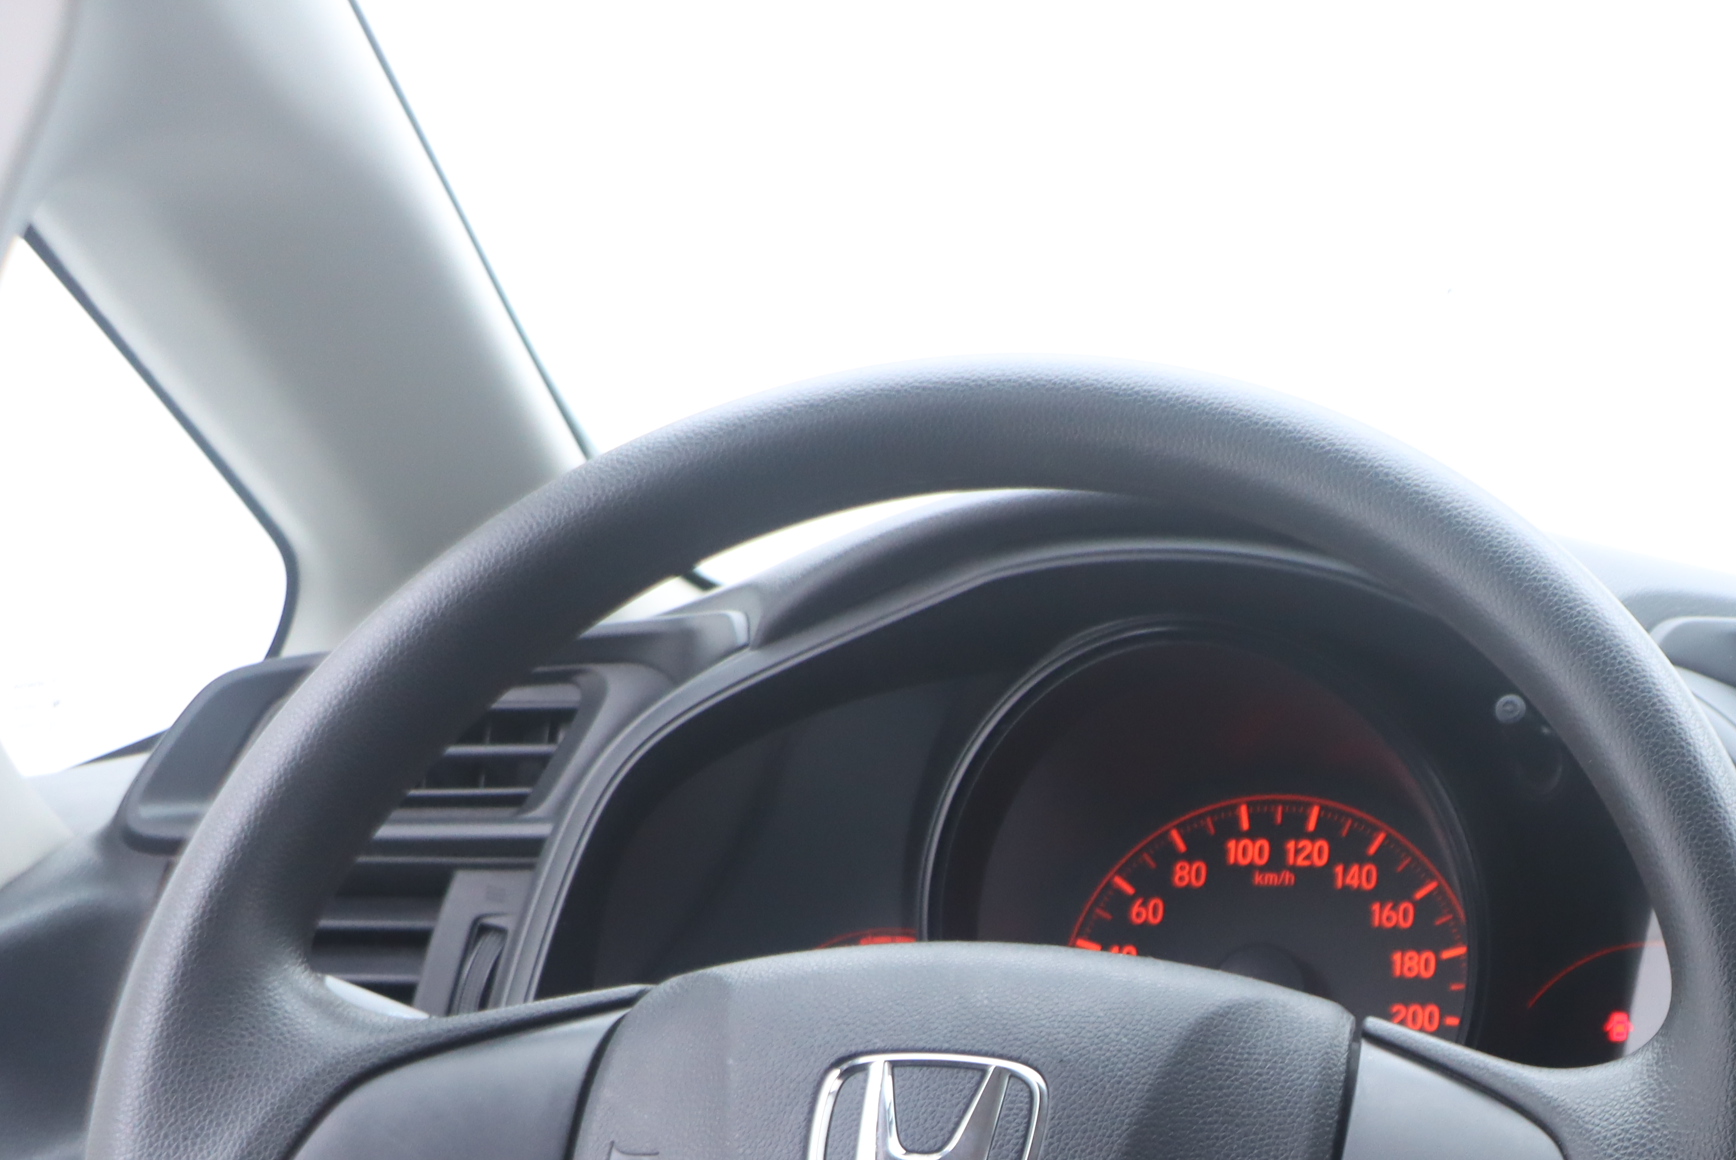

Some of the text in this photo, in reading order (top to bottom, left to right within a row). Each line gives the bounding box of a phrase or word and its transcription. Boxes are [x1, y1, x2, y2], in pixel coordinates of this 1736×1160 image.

[1227, 838, 1271, 866] 100
[1286, 839, 1330, 867] 120
[1173, 860, 1208, 888] 80
[1254, 870, 1295, 886] km/h
[1335, 863, 1378, 890] 140
[1129, 897, 1165, 925] 60
[1371, 901, 1415, 929] 160
[1391, 950, 1437, 979] 180
[1390, 1003, 1441, 1032] 200
